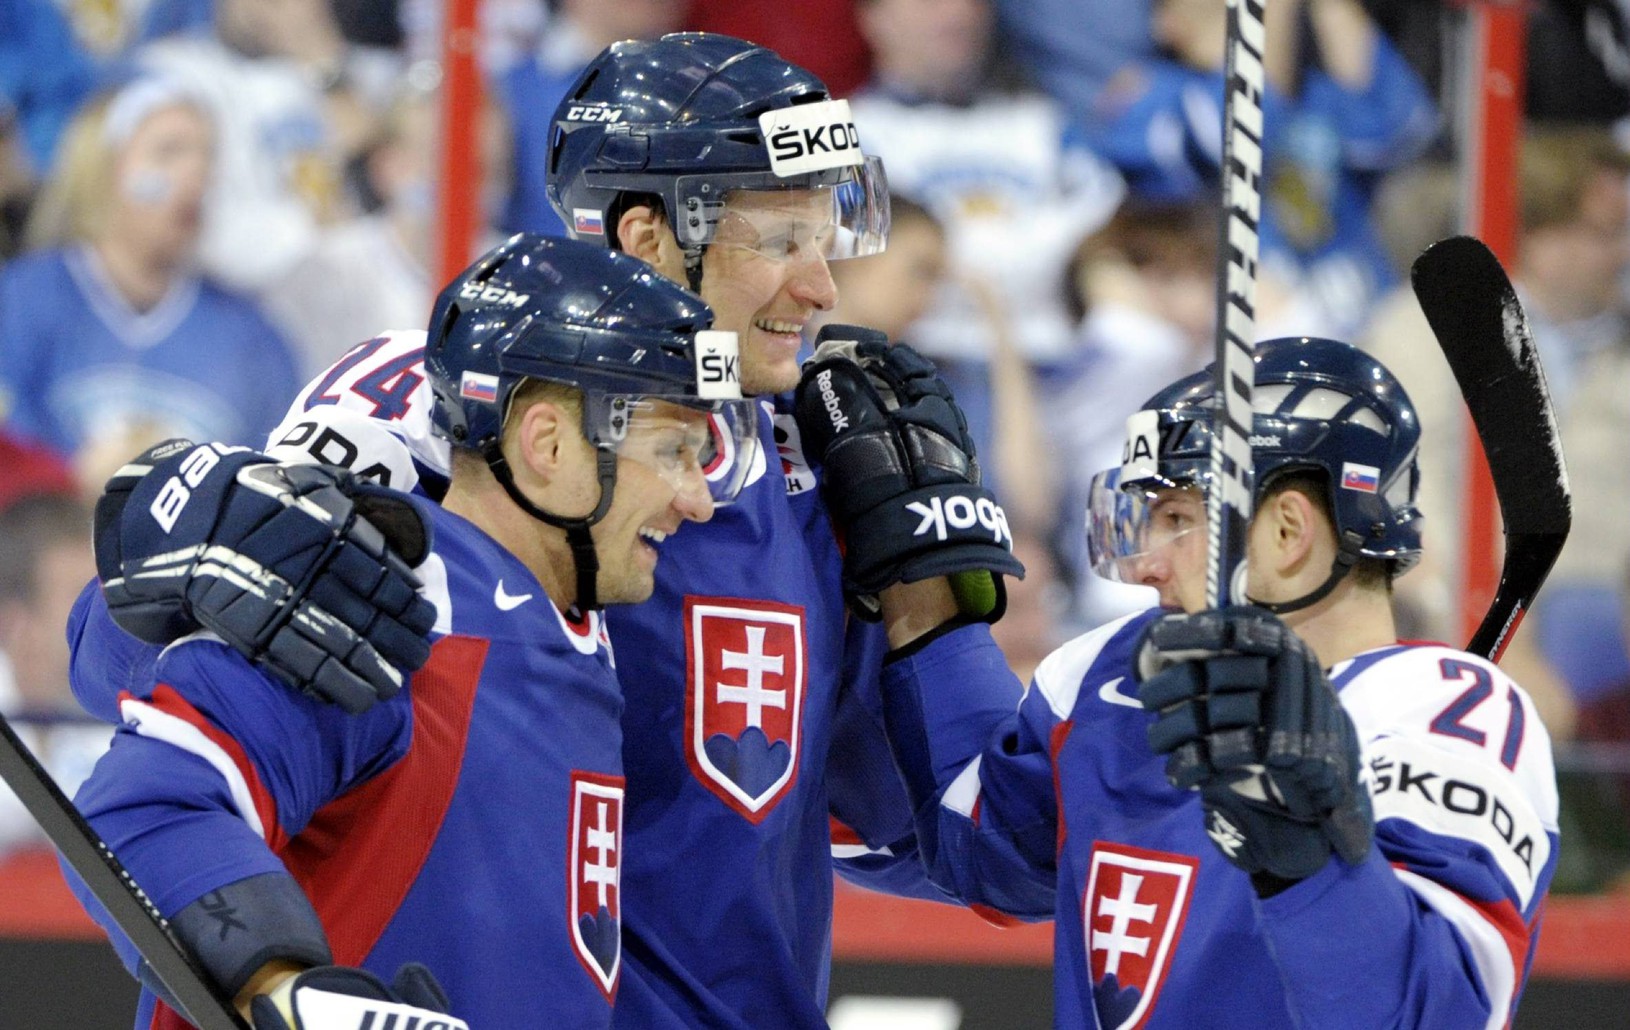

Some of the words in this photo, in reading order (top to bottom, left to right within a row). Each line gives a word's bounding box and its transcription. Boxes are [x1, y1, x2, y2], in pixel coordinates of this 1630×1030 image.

[567, 106, 623, 123] CCM
[460, 284, 530, 308] CCM
[702, 348, 740, 382] ŠK
[816, 369, 850, 434] Reebok
[1488, 599, 1522, 661] SYNERGY
[1429, 657, 1526, 774] 21
[1370, 755, 1534, 881] ŠKODA
